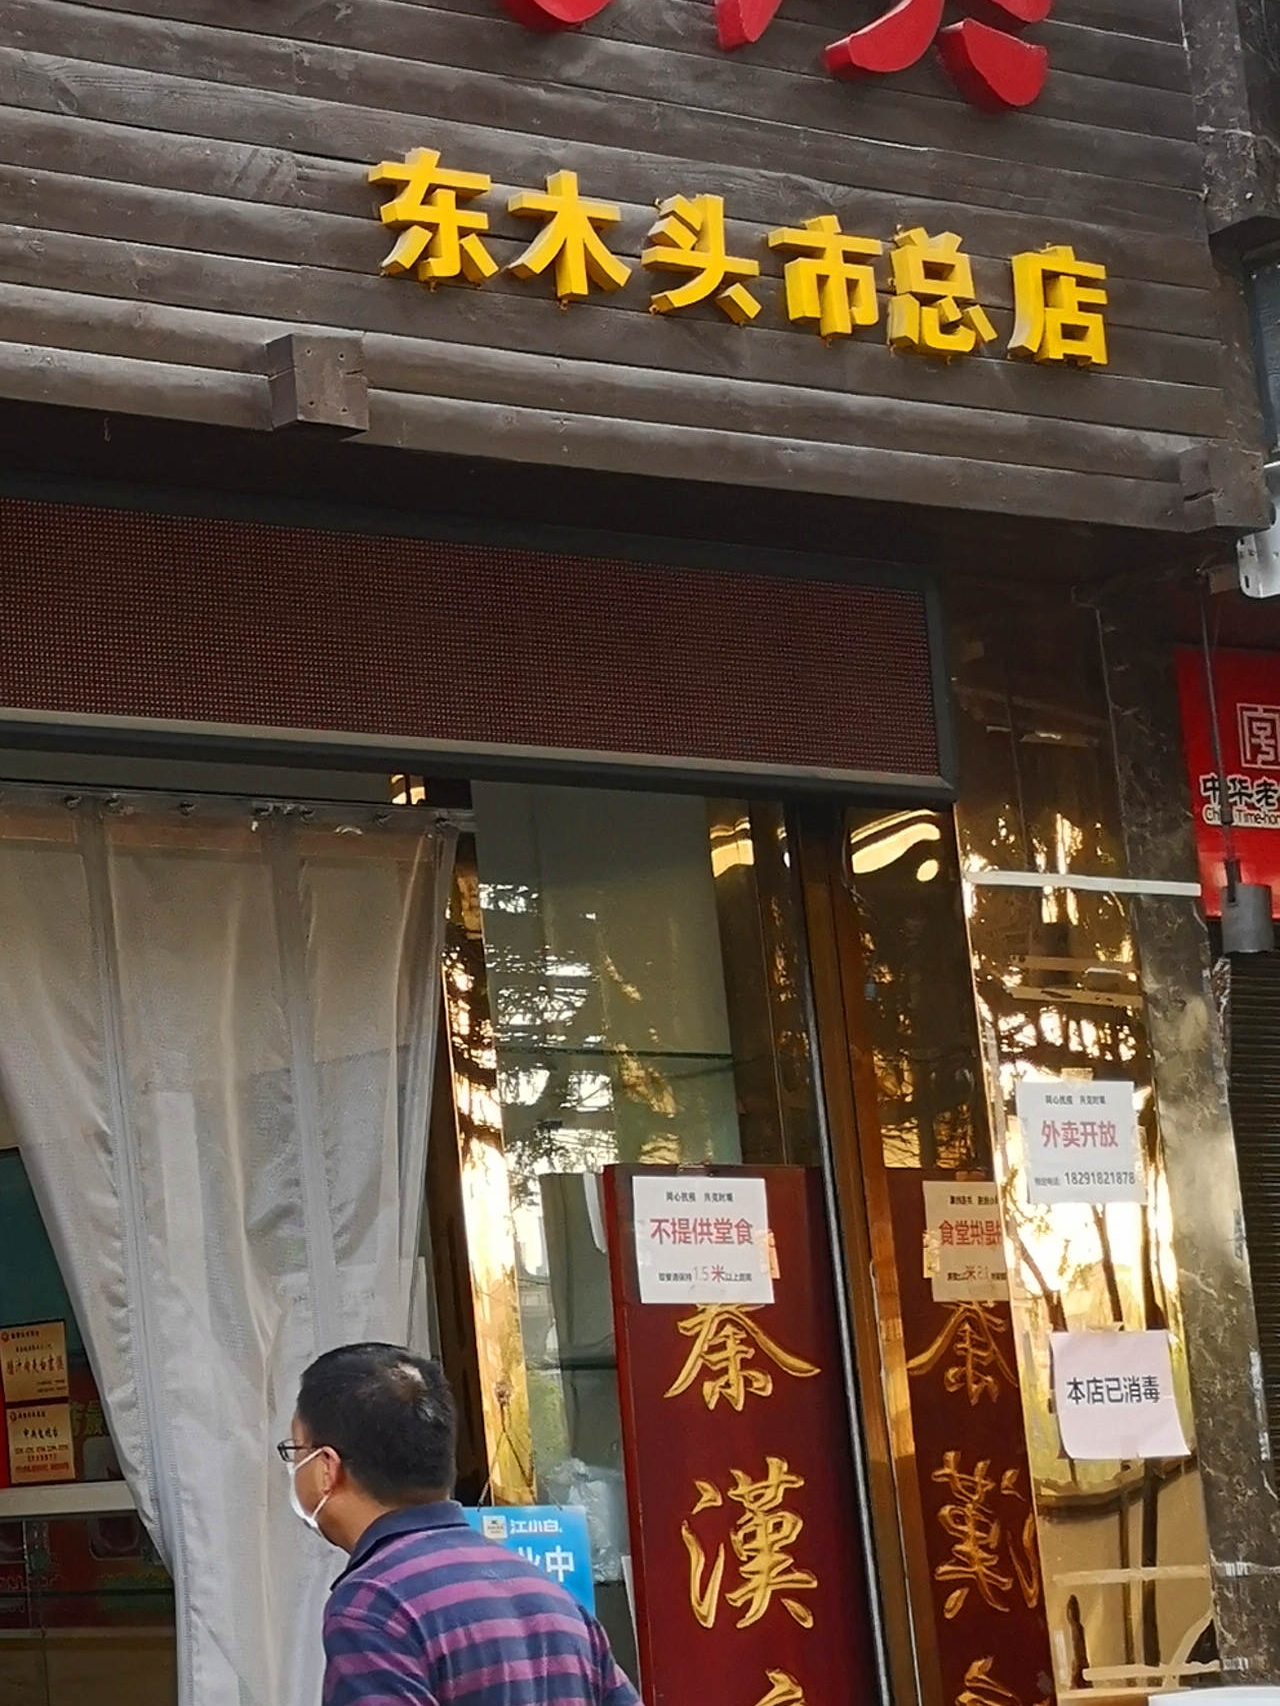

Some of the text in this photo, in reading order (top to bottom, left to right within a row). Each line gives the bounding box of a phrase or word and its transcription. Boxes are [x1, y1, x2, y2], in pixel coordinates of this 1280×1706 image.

[368, 146, 1112, 369] 东木头市总店
[1041, 1120, 1119, 1149] 外卖开放
[1065, 1172, 1136, 1185] 18291821878
[650, 1217, 754, 1245] 不提供堂食
[1066, 1375, 1161, 1407] 本店已消毒
